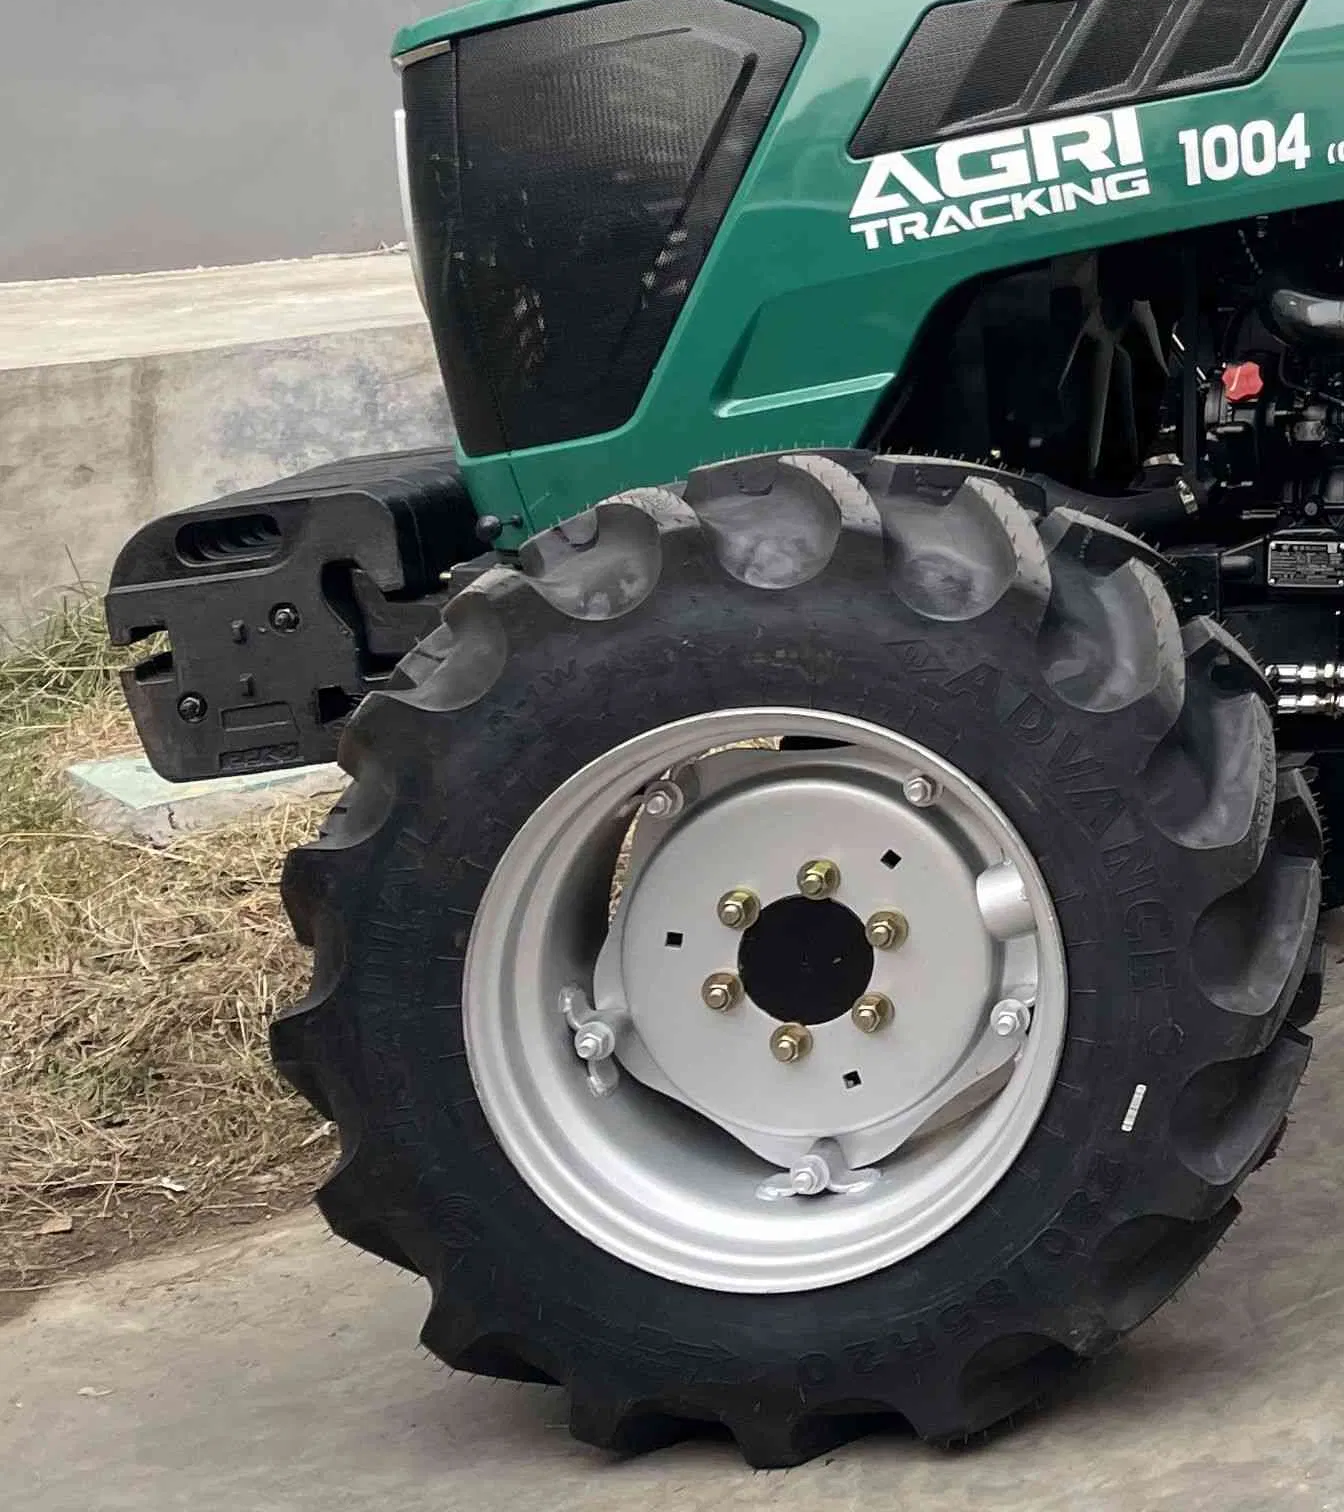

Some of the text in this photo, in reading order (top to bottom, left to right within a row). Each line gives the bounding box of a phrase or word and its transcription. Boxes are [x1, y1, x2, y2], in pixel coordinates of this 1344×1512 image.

[849, 106, 1146, 219] AGRI
[1178, 112, 1311, 186] 1004
[850, 168, 1151, 250] TRACKING
[943, 661, 1178, 992] ADVANCE
